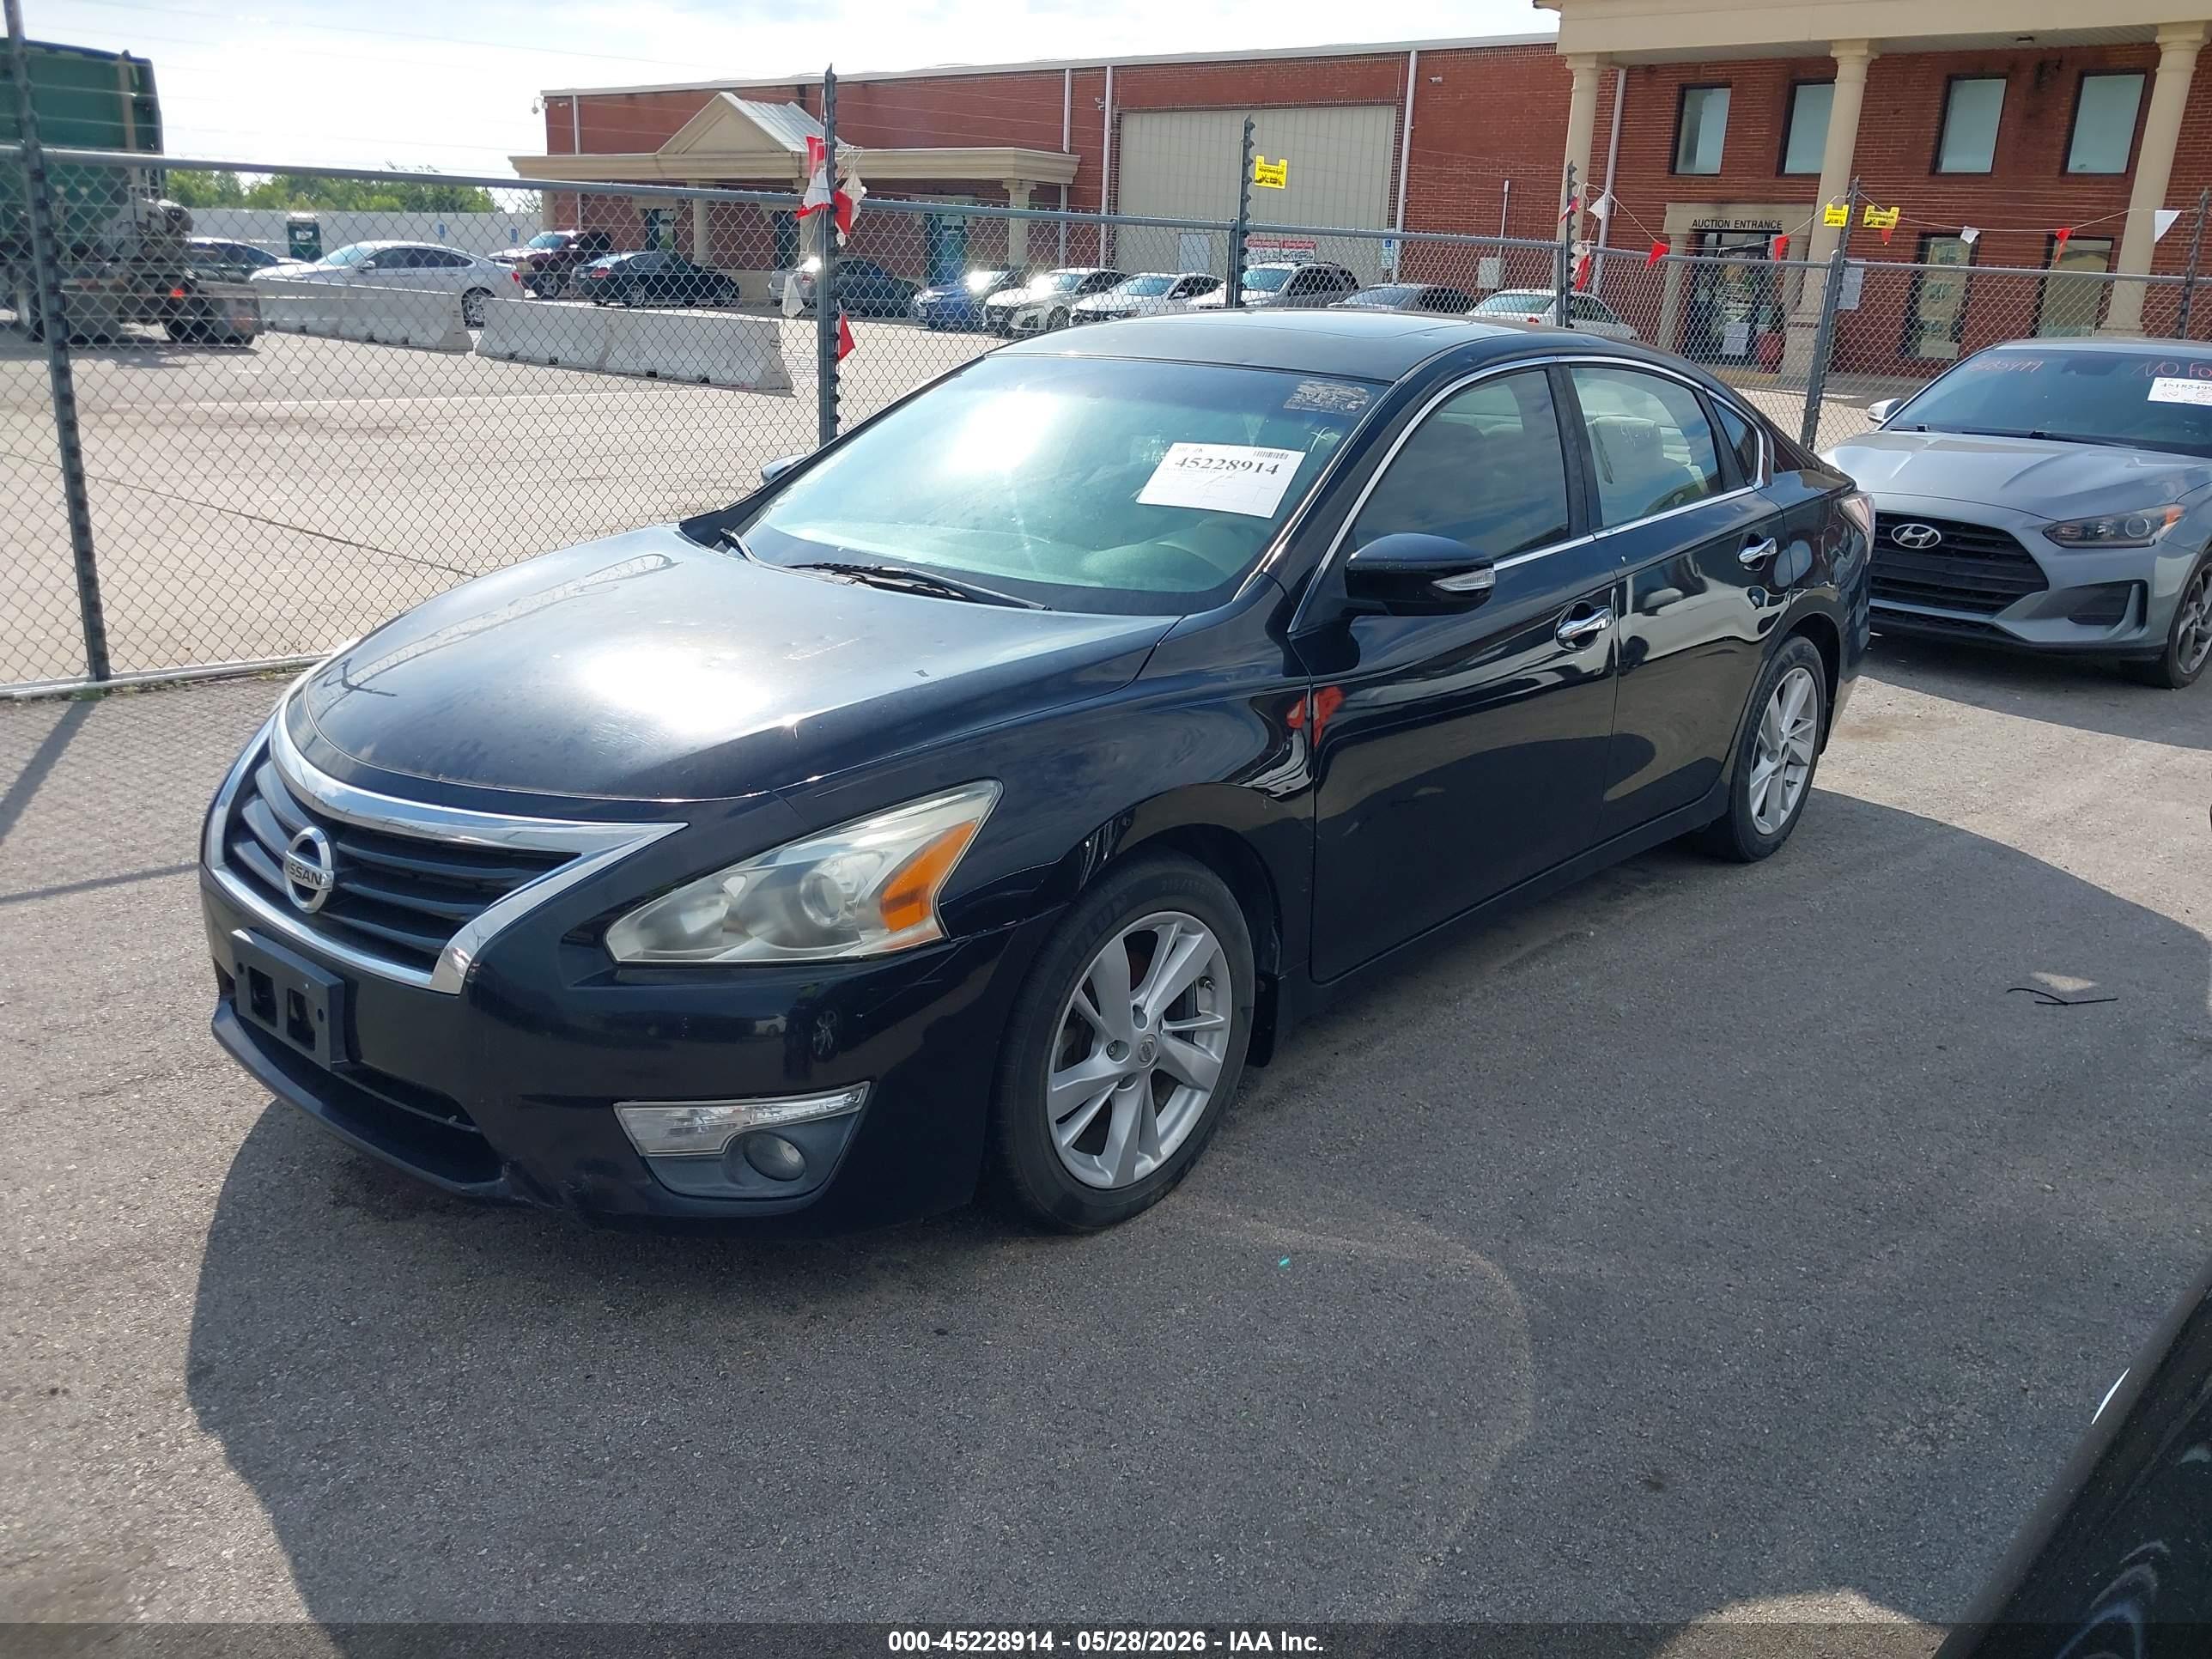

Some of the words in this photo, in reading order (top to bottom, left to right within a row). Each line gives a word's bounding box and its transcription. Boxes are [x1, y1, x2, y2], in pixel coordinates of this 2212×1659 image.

[1692, 219, 1730, 228] AUCTION
[1734, 220, 1784, 229] ENTRANCE
[2130, 361, 2179, 377] NO
[1175, 456, 1279, 475] 45228914
